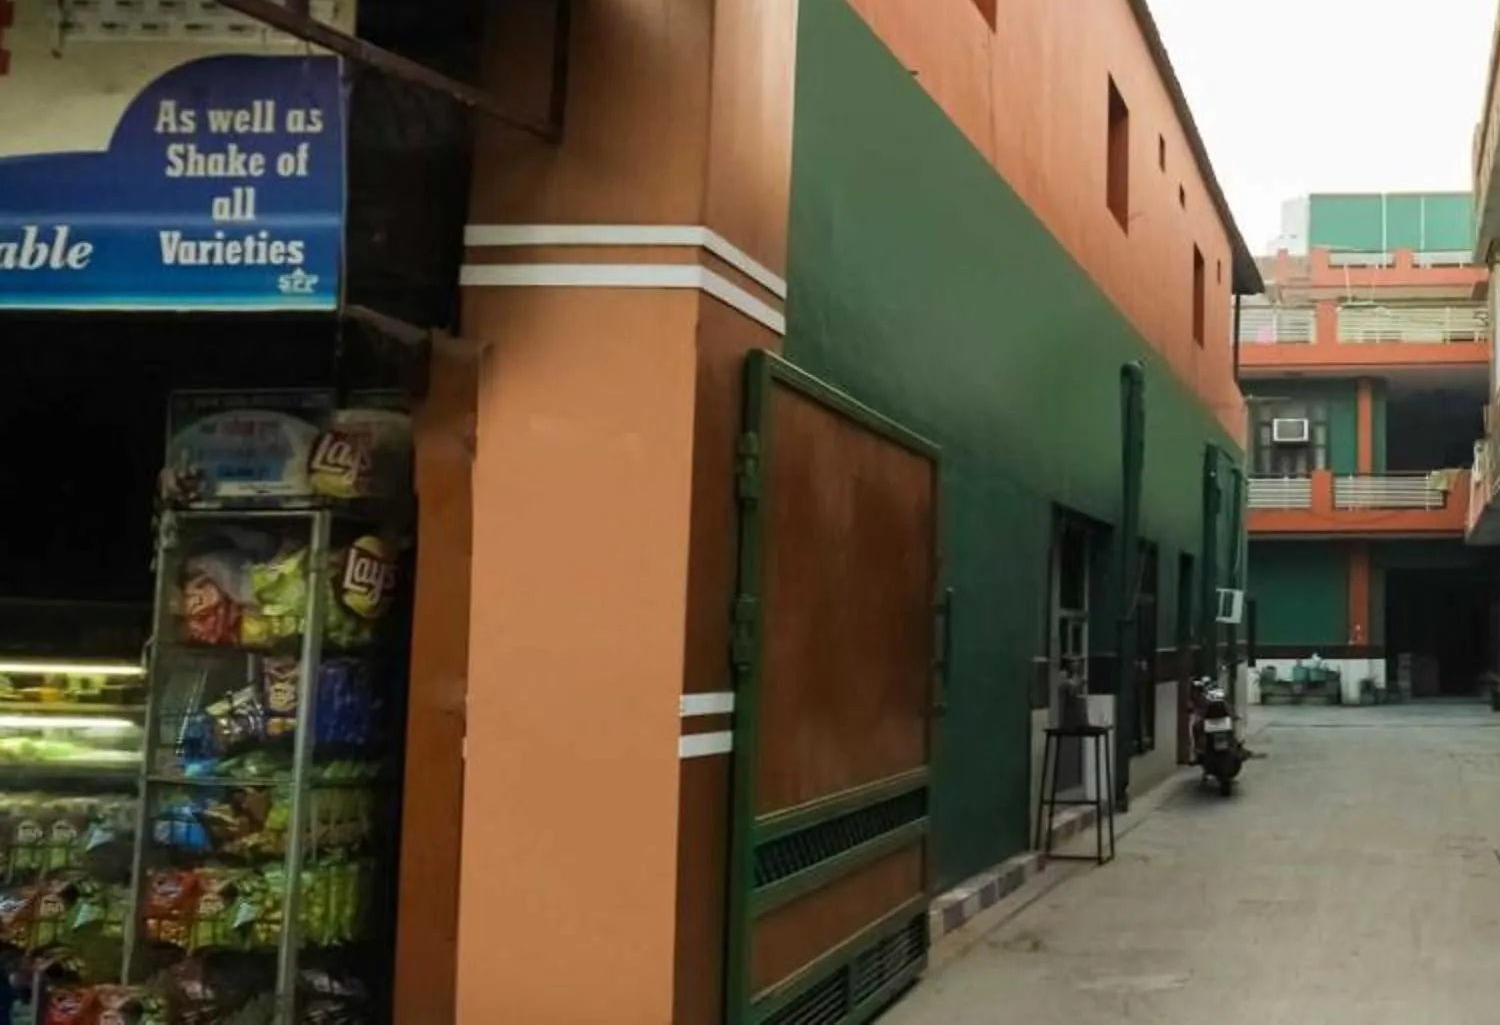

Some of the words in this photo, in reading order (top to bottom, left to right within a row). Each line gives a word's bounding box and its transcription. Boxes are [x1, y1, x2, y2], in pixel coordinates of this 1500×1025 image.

[155, 100, 196, 133] As
[208, 100, 275, 133] well
[286, 107, 324, 133] as
[165, 143, 266, 177] Shake
[277, 142, 310, 177] of
[211, 186, 256, 222] all
[0, 224, 94, 269] able
[159, 231, 305, 266] Varieties
